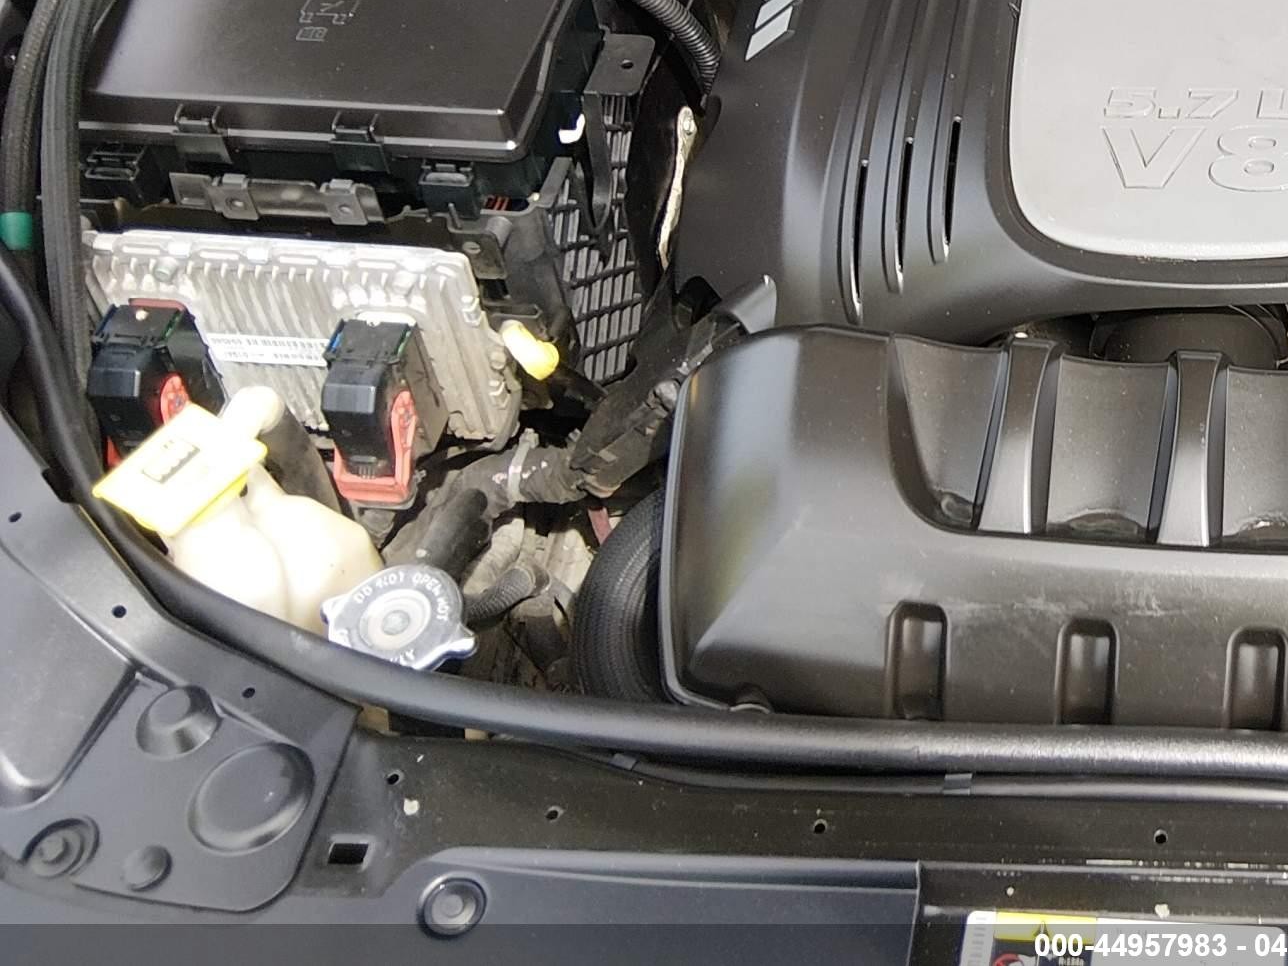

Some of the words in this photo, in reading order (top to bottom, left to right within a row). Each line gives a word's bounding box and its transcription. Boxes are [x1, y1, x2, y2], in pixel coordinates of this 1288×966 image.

[354, 586, 372, 604] DO
[376, 572, 404, 588] NOT
[412, 572, 441, 596] OPEN
